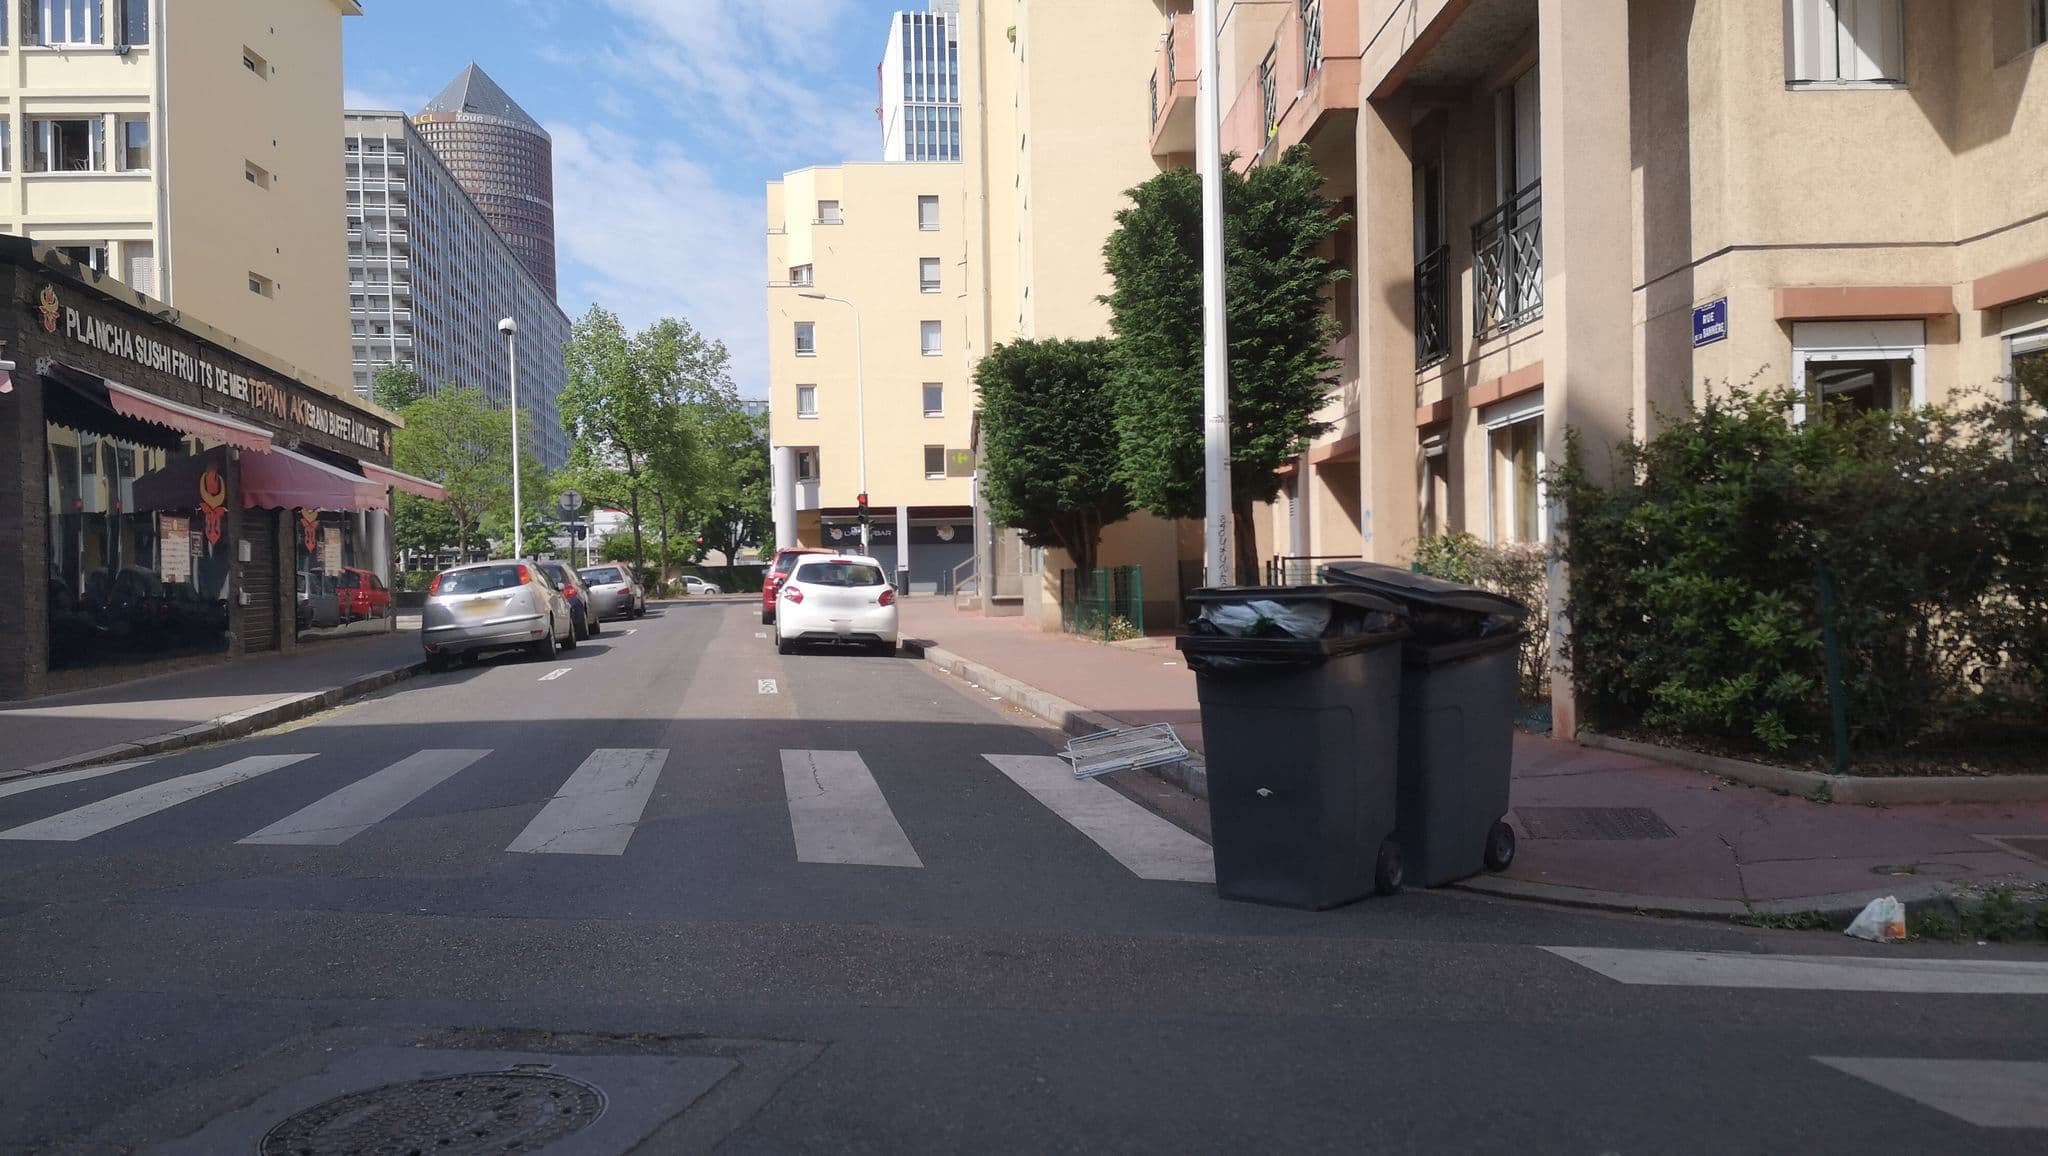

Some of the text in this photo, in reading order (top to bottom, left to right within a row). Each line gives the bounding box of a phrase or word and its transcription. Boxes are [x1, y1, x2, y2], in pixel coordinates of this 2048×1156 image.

[414, 113, 436, 125] LCL
[456, 113, 484, 123] TOUR
[1703, 312, 1714, 324] RUE
[66, 306, 134, 361] PLANCHA
[135, 334, 171, 374] SUSHI
[215, 366, 229, 395] DE
[228, 372, 249, 402] MER
[249, 378, 287, 422] TEPPAN
[306, 402, 329, 433] GRAND
[329, 411, 351, 440] BUFFET
